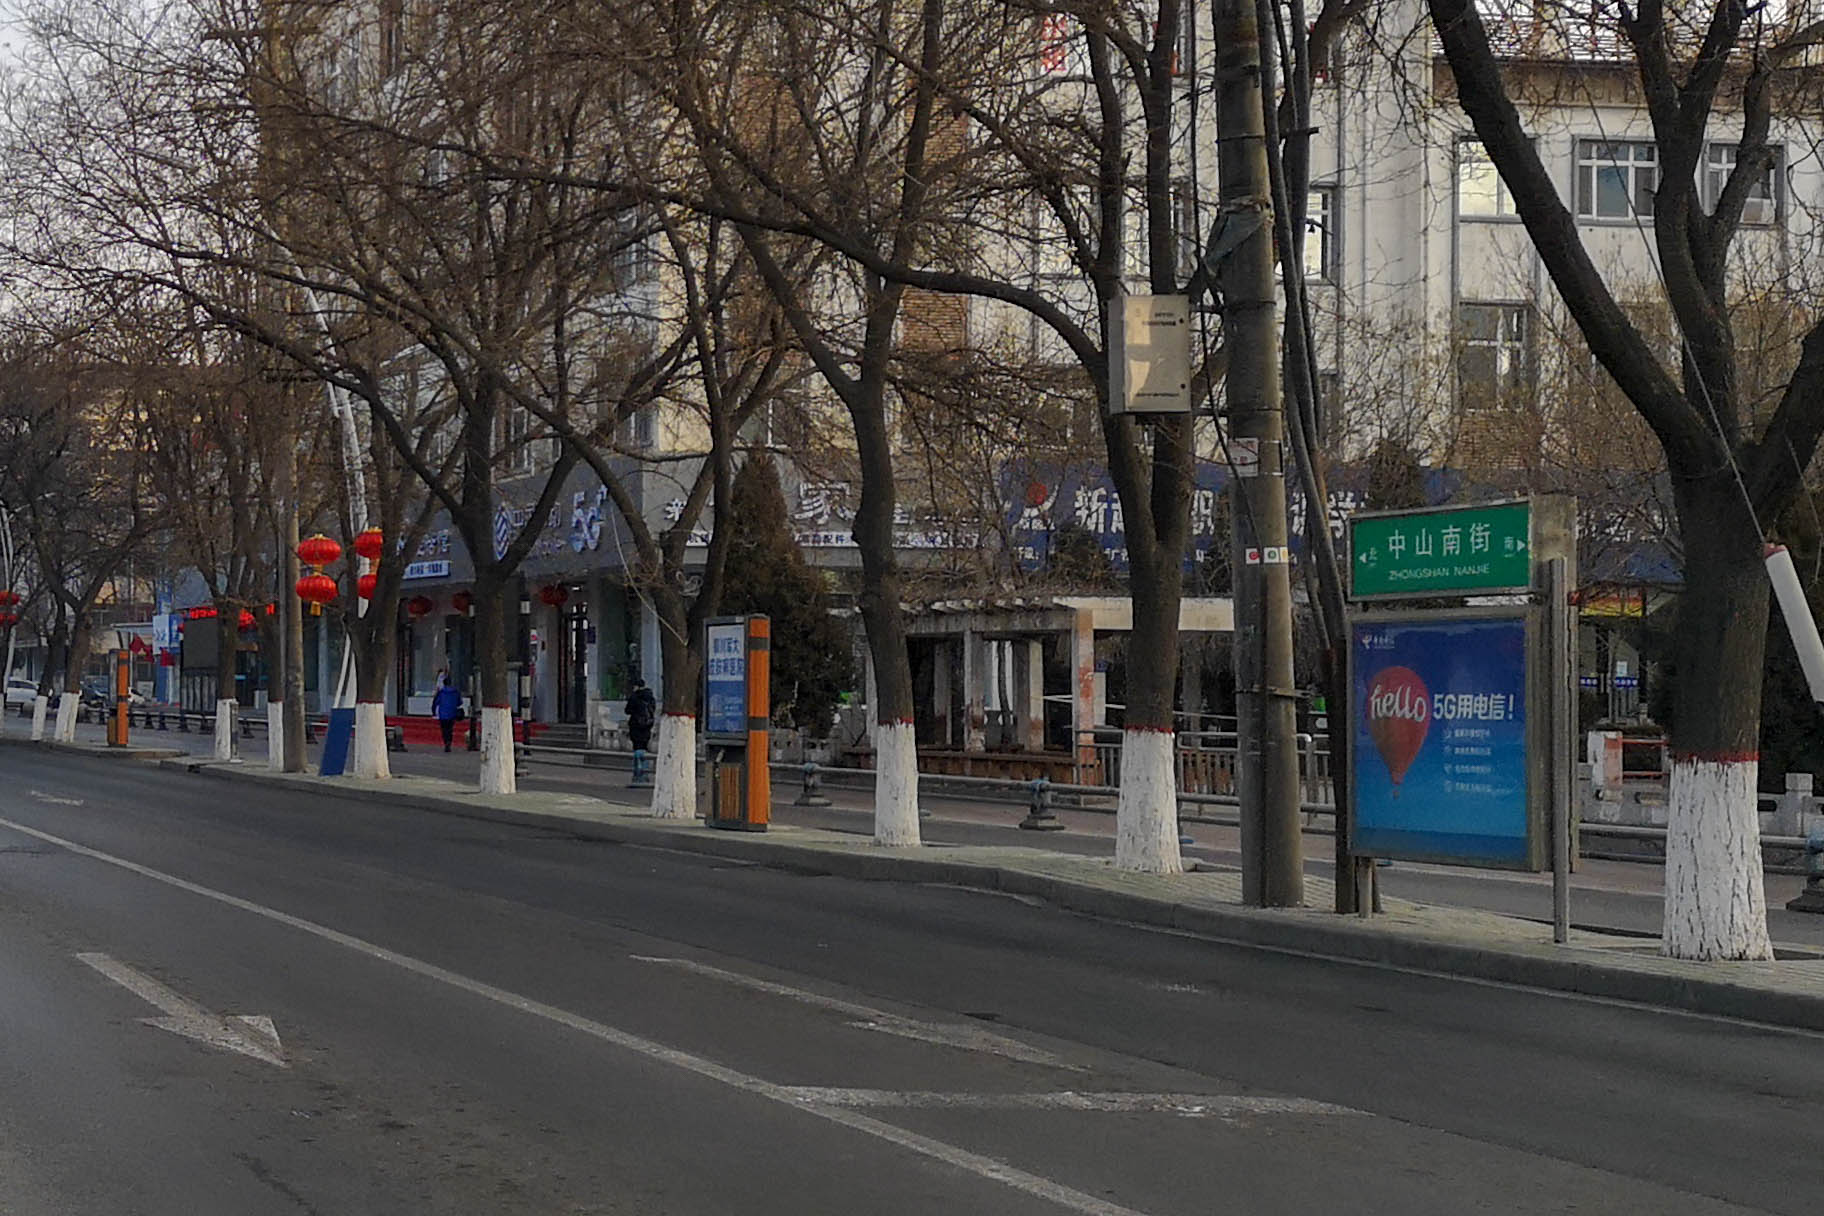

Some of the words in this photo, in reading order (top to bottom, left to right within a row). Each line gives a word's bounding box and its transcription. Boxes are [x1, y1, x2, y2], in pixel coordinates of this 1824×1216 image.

[1387, 522, 1492, 561] 中山南街
[1387, 567, 1450, 581] ZHONGSHAN
[1453, 563, 1491, 578] NANJIE
[1369, 683, 1427, 723] hello
